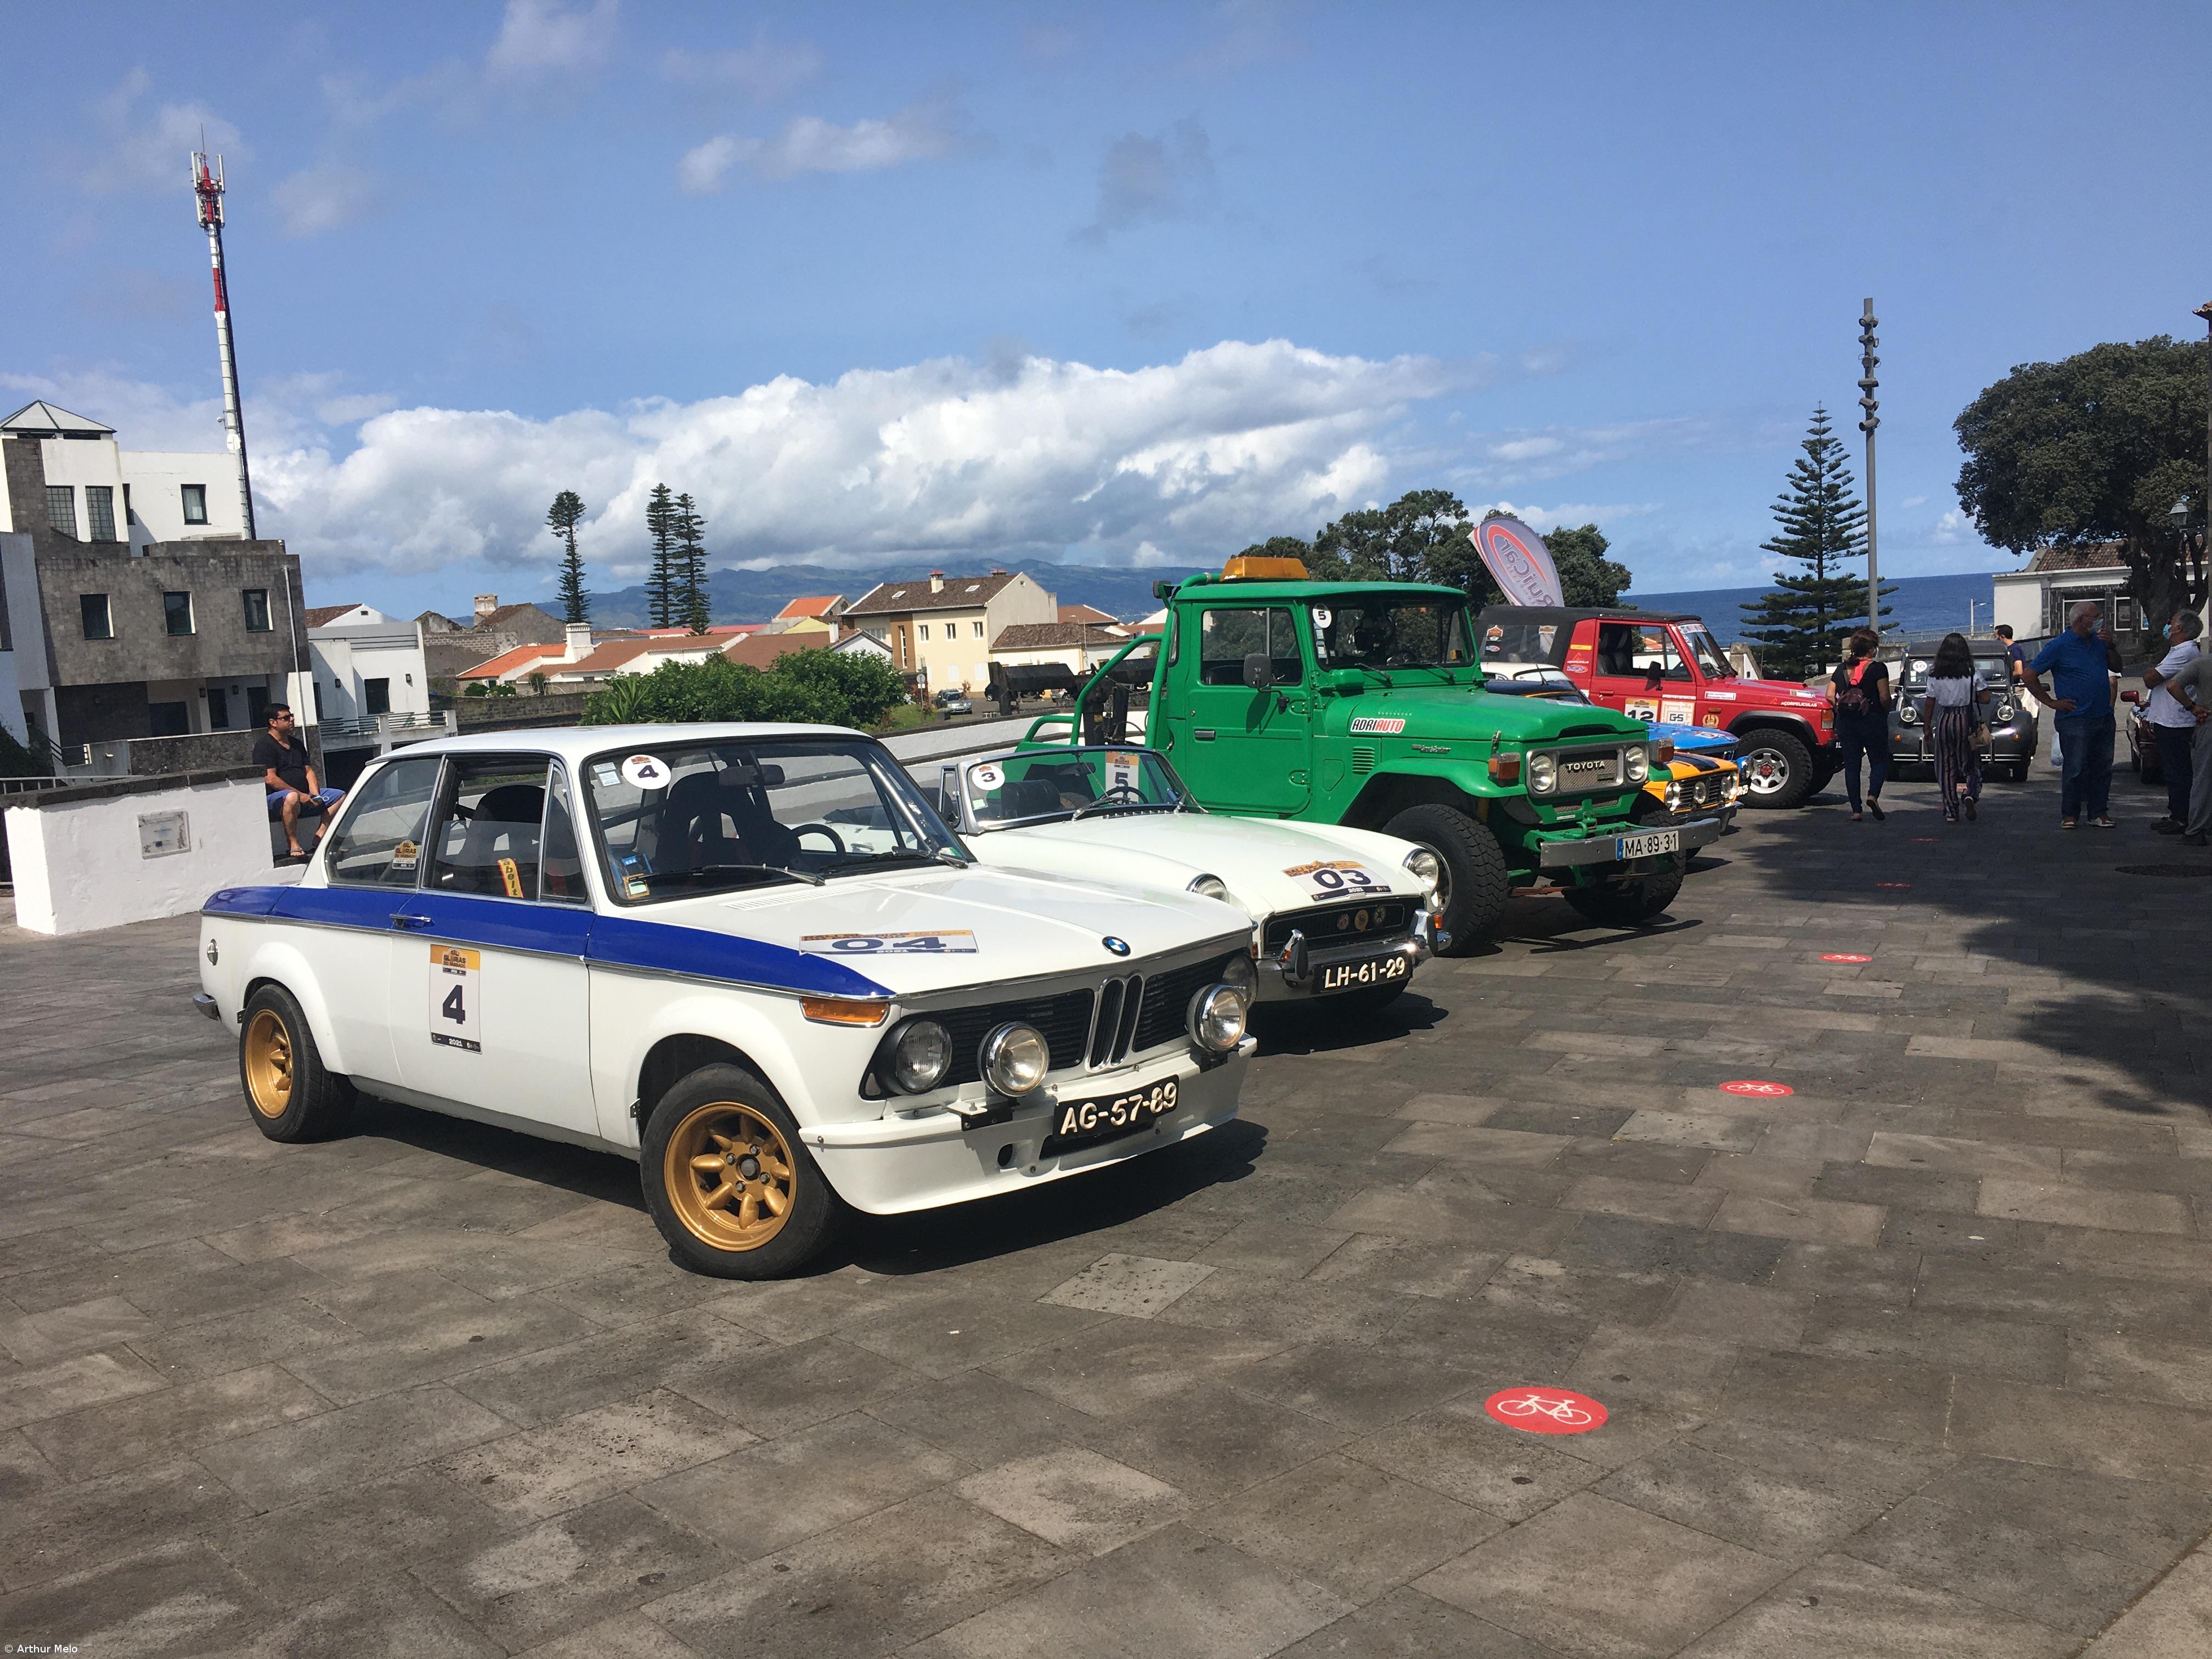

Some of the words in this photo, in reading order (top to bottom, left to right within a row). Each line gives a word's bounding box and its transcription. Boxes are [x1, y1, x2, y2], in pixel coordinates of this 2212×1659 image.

[1318, 611, 1326, 620] 5
[1628, 709, 1654, 722] 12
[1669, 713, 1684, 721] GS
[1352, 719, 1404, 732] ADRIAUTO
[637, 765, 659, 778] 4
[1567, 760, 1605, 771] TOYOTA
[981, 772, 996, 782] 3
[1115, 771, 1128, 788] 5
[1313, 870, 1372, 889] 03
[832, 936, 947, 950] 04
[1324, 956, 1406, 989] LH-61-29
[442, 984, 466, 1025] 4
[449, 1038, 463, 1047] 2021
[1060, 1082, 1177, 1135] AG-57-89
